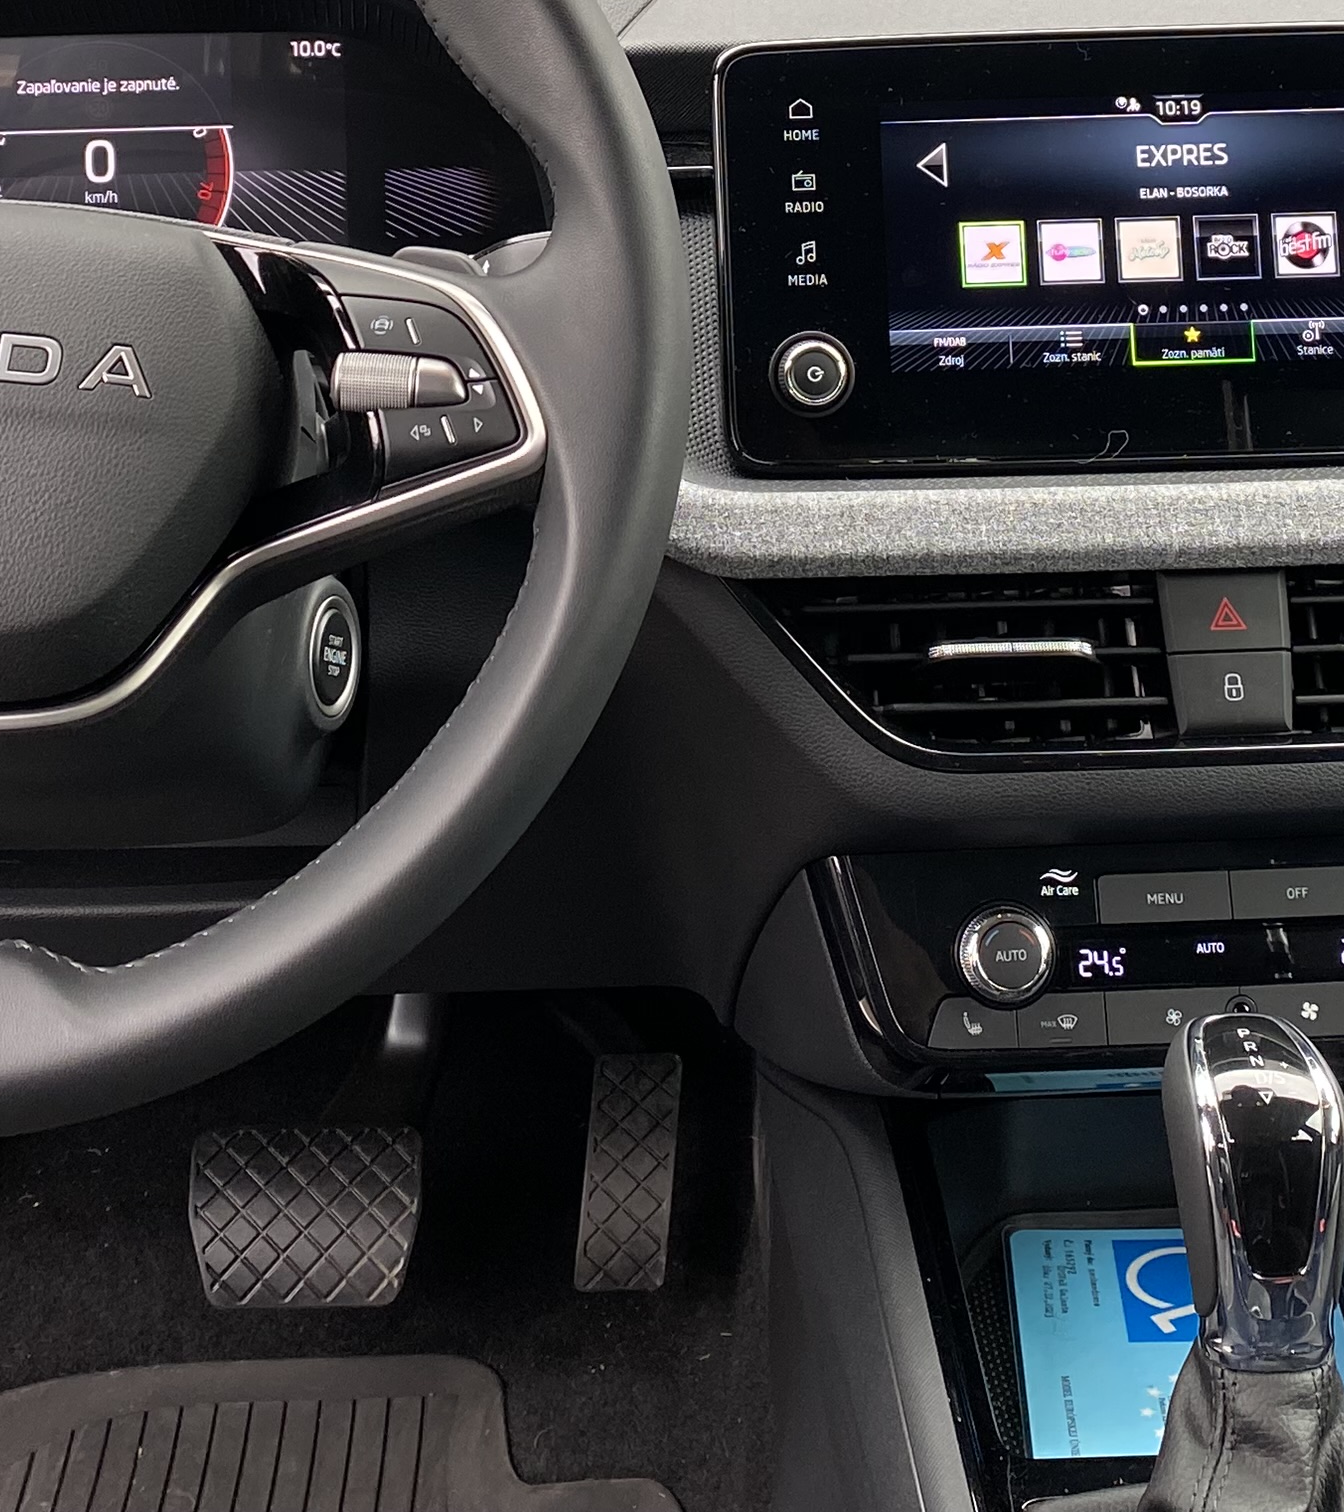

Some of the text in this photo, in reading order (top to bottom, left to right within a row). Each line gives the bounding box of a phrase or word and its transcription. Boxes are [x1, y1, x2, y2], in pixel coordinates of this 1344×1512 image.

[102, 78, 117, 95] je
[119, 76, 180, 94] zapnuté.
[1156, 100, 1202, 116] 10:19
[784, 129, 819, 140] HOME
[84, 139, 116, 184] 0
[1136, 143, 1228, 168] EXPRES
[84, 191, 119, 204] km/h
[1139, 187, 1168, 199] ELAN
[1177, 186, 1228, 198] BOSORKA
[785, 201, 824, 213] RADIO
[788, 274, 828, 286] MEDIA
[934, 337, 966, 348] FM/DAB
[1161, 348, 1188, 359] Zozn.
[1297, 344, 1333, 356] Stanice
[939, 355, 964, 367] Zdroj
[1043, 351, 1101, 363] Zozn. stanic
[323, 646, 347, 666] ENGINE
[327, 664, 340, 677] STOP
[1040, 885, 1079, 896] Air Care
[1286, 887, 1309, 900] OFF
[1146, 892, 1184, 905] MENU
[1196, 942, 1225, 954] AUTO
[995, 949, 1027, 962] AUTO
[1236, 1028, 1251, 1039] P
[1243, 1041, 1258, 1052] R
[1249, 1054, 1265, 1067] N
